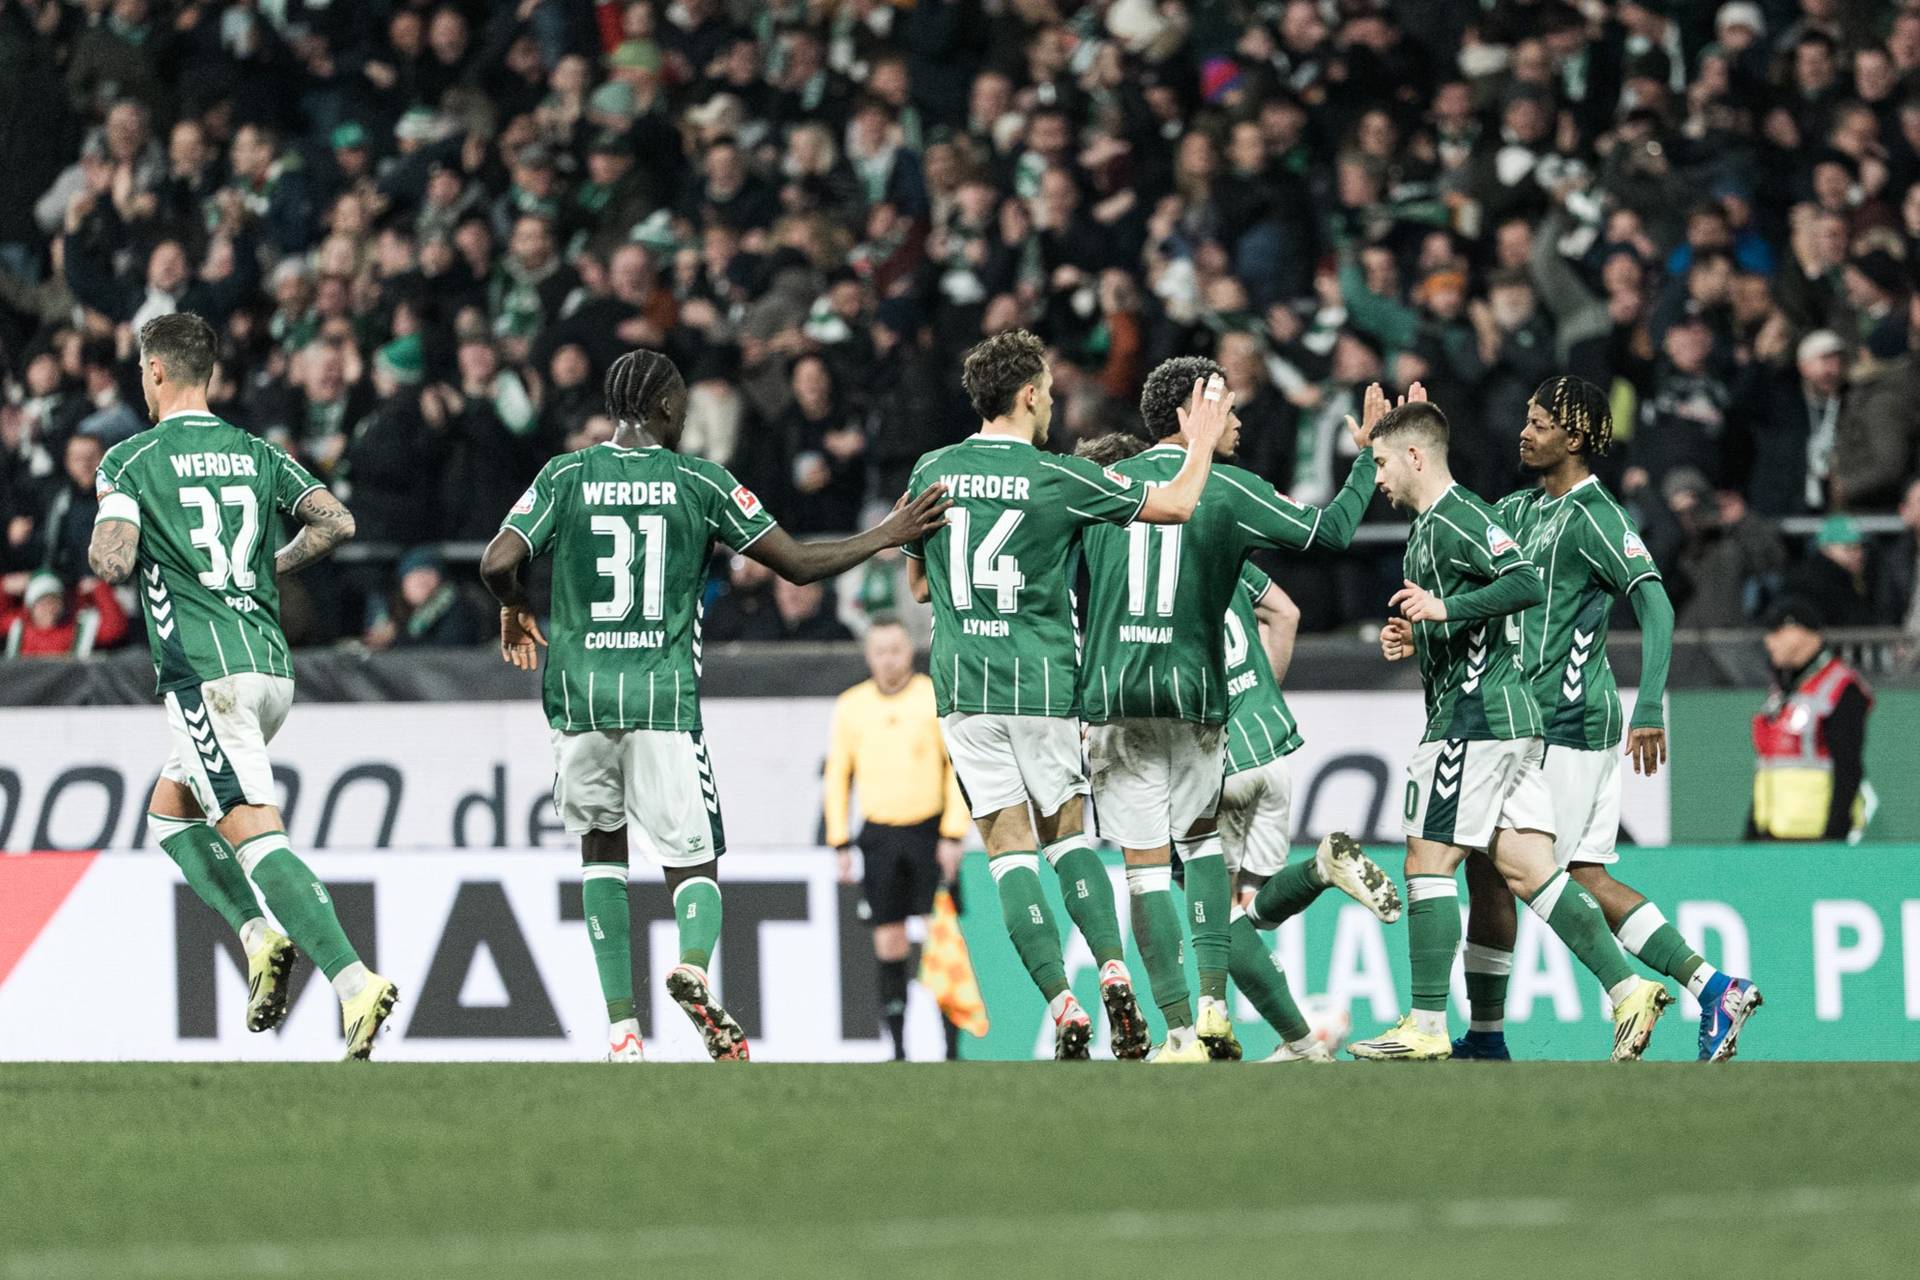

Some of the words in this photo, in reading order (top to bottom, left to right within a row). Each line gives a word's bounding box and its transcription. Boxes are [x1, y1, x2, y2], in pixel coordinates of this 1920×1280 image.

[170, 452, 257, 477] WERDER
[583, 481, 677, 505] WERDER
[940, 474, 1030, 500] WERDER
[178, 485, 259, 591] 37
[590, 515, 667, 622] 31
[944, 507, 1025, 613] 14
[1124, 520, 1182, 617] 11
[963, 618, 1010, 637] LYNEN
[1119, 624, 1173, 644] NINMAH
[585, 631, 665, 650] COULIBALY
